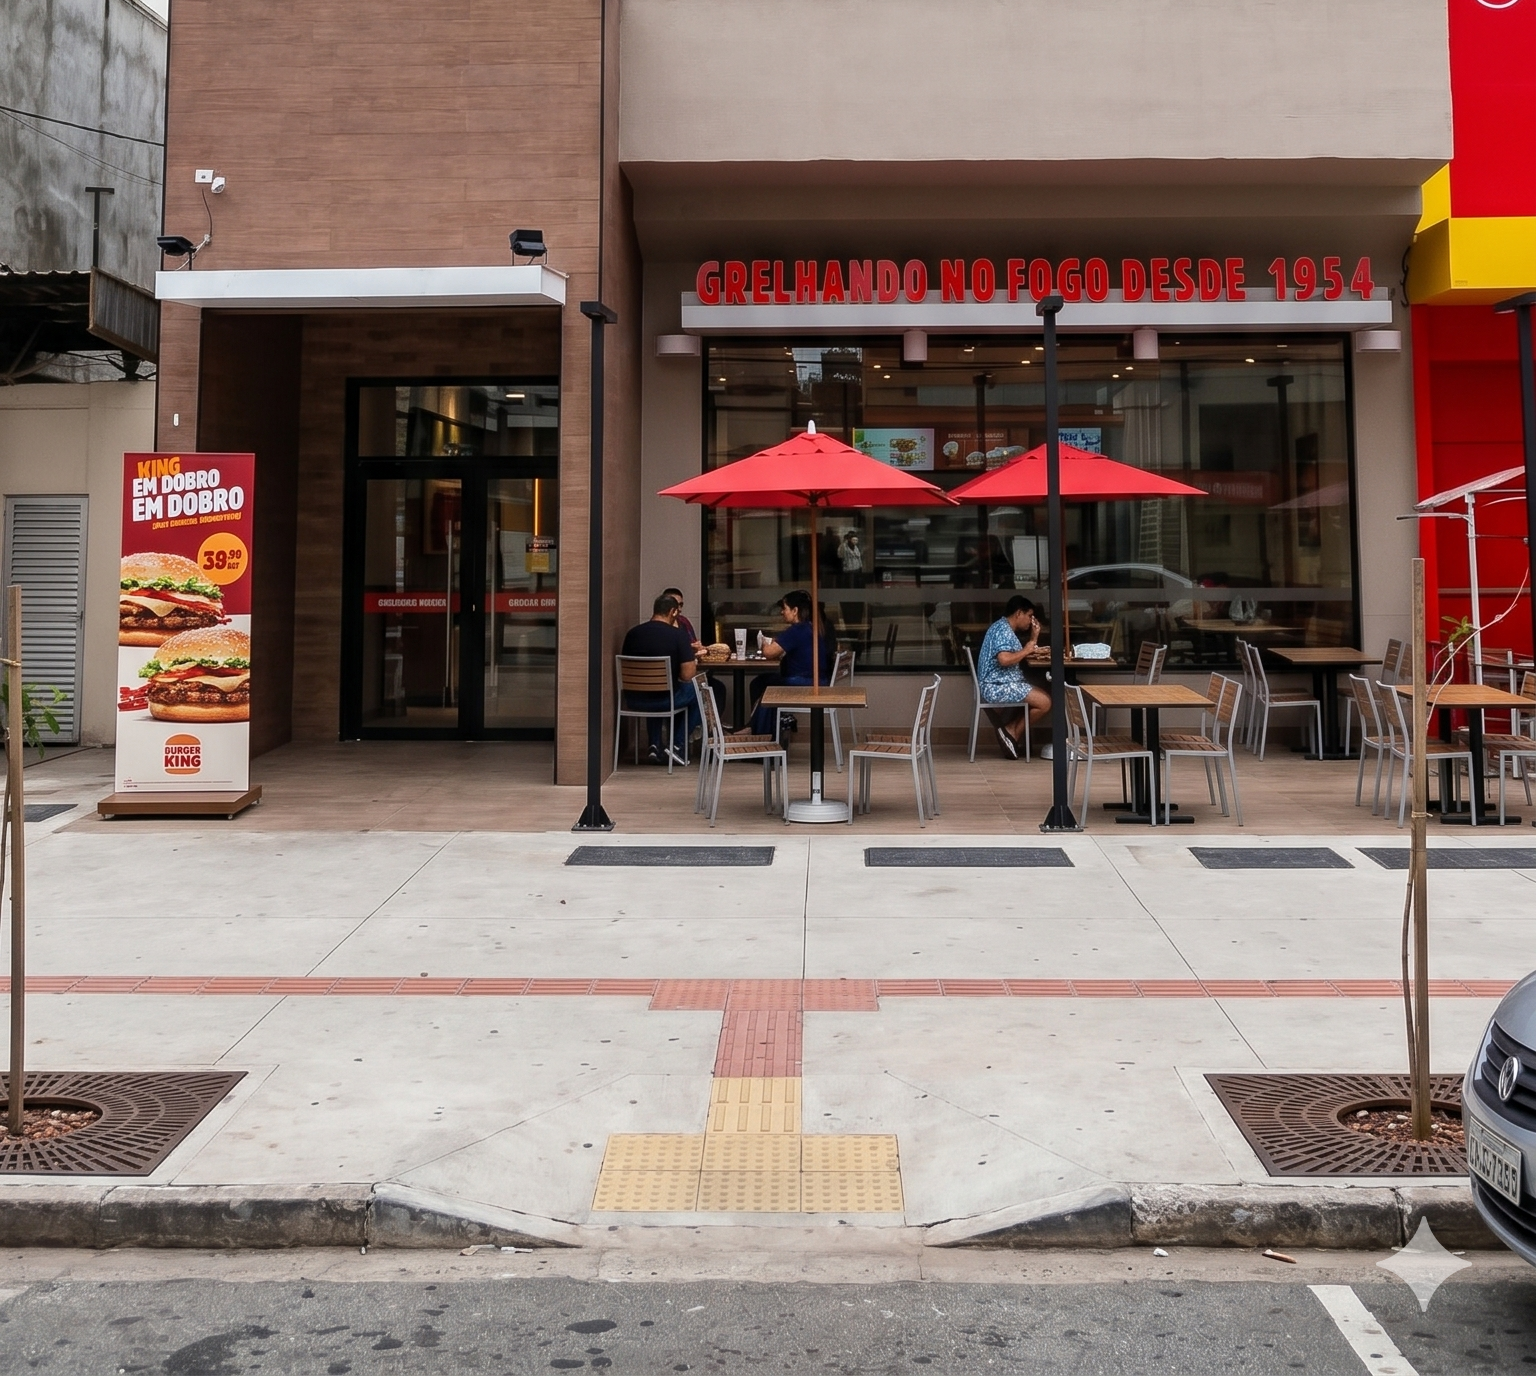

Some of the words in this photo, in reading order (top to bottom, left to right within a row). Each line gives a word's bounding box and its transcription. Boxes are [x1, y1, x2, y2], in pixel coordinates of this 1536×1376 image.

[696, 259, 928, 305] GRELHANDO
[940, 258, 995, 303] NO
[1007, 257, 1110, 303] FOGO
[1121, 257, 1246, 303] DESDE
[1267, 256, 1376, 302] 1954
[137, 457, 180, 479] KING
[132, 476, 158, 497] EM
[161, 468, 221, 494] DOBRO
[132, 495, 164, 522] EM
[167, 485, 245, 518] DOBRO
[164, 746, 201, 755] BURGER
[164, 755, 202, 768] KING
